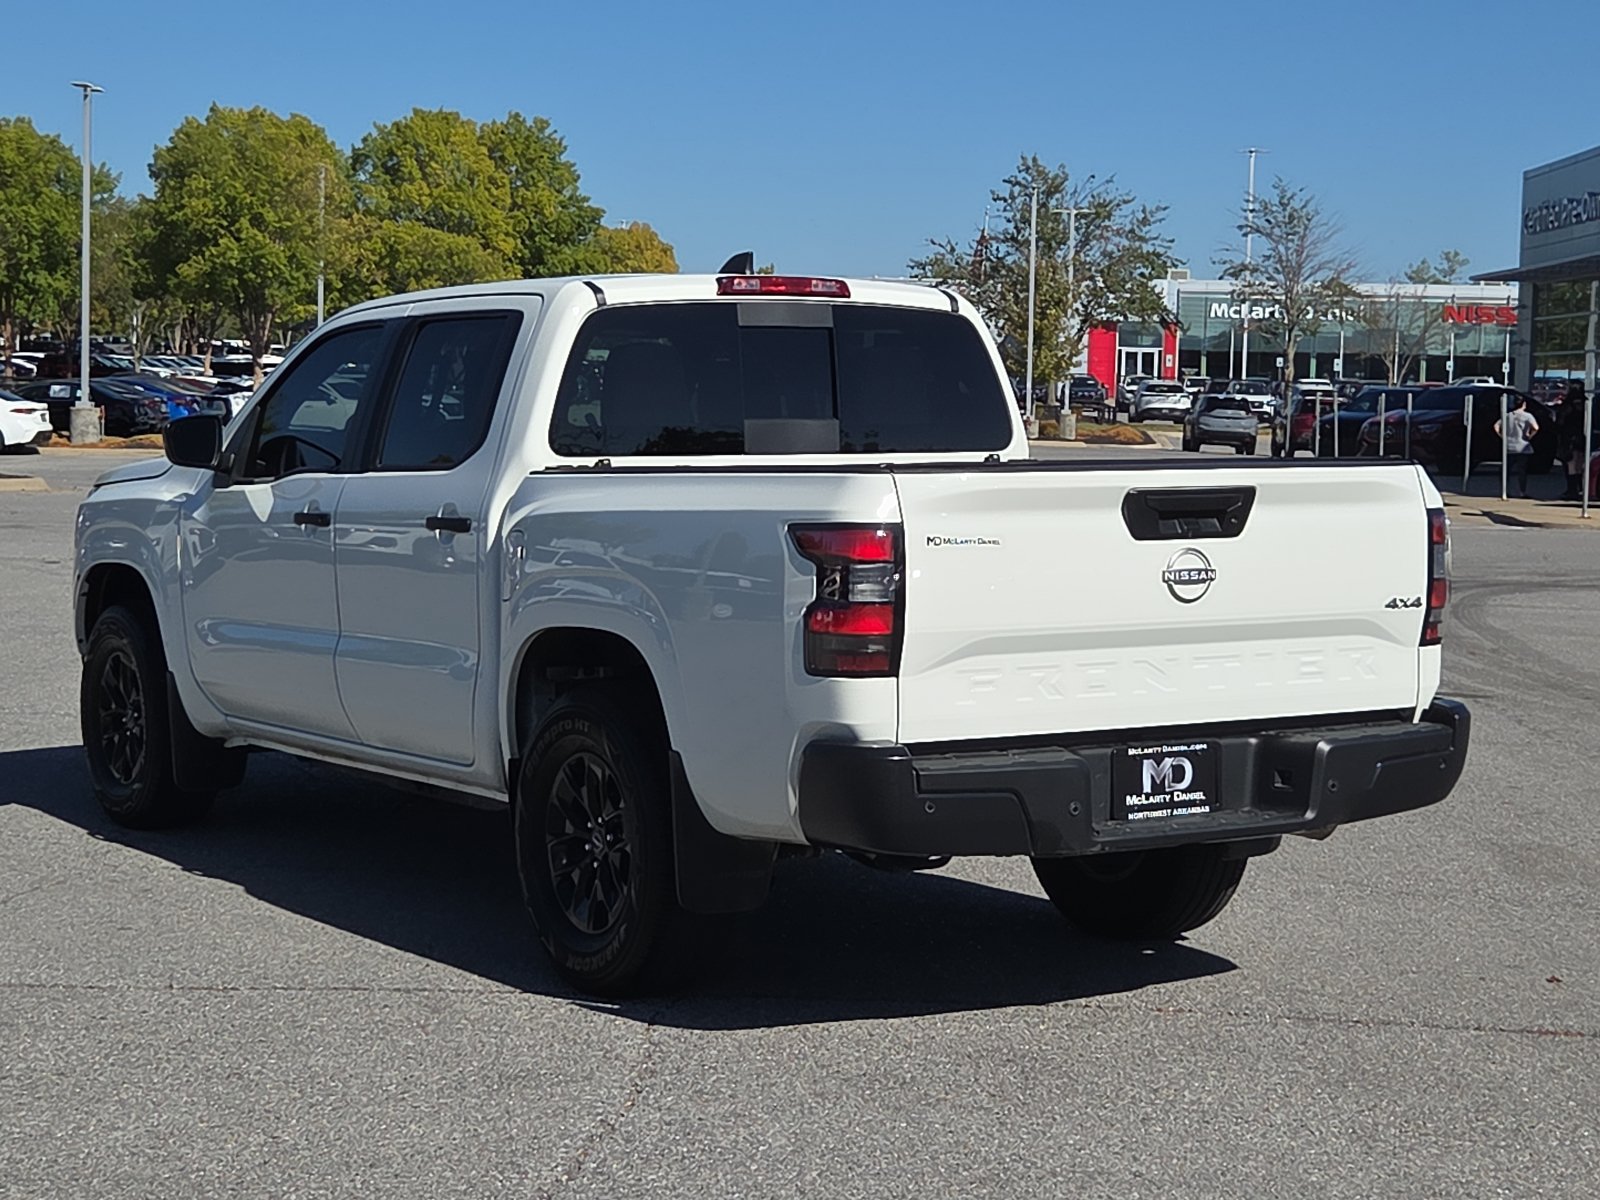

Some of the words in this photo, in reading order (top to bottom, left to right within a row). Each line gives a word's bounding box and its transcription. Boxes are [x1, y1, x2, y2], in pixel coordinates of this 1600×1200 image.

[1164, 570, 1216, 581] NISSAN
[955, 645, 1379, 706] FRONTIER
[1142, 757, 1193, 793] MD
